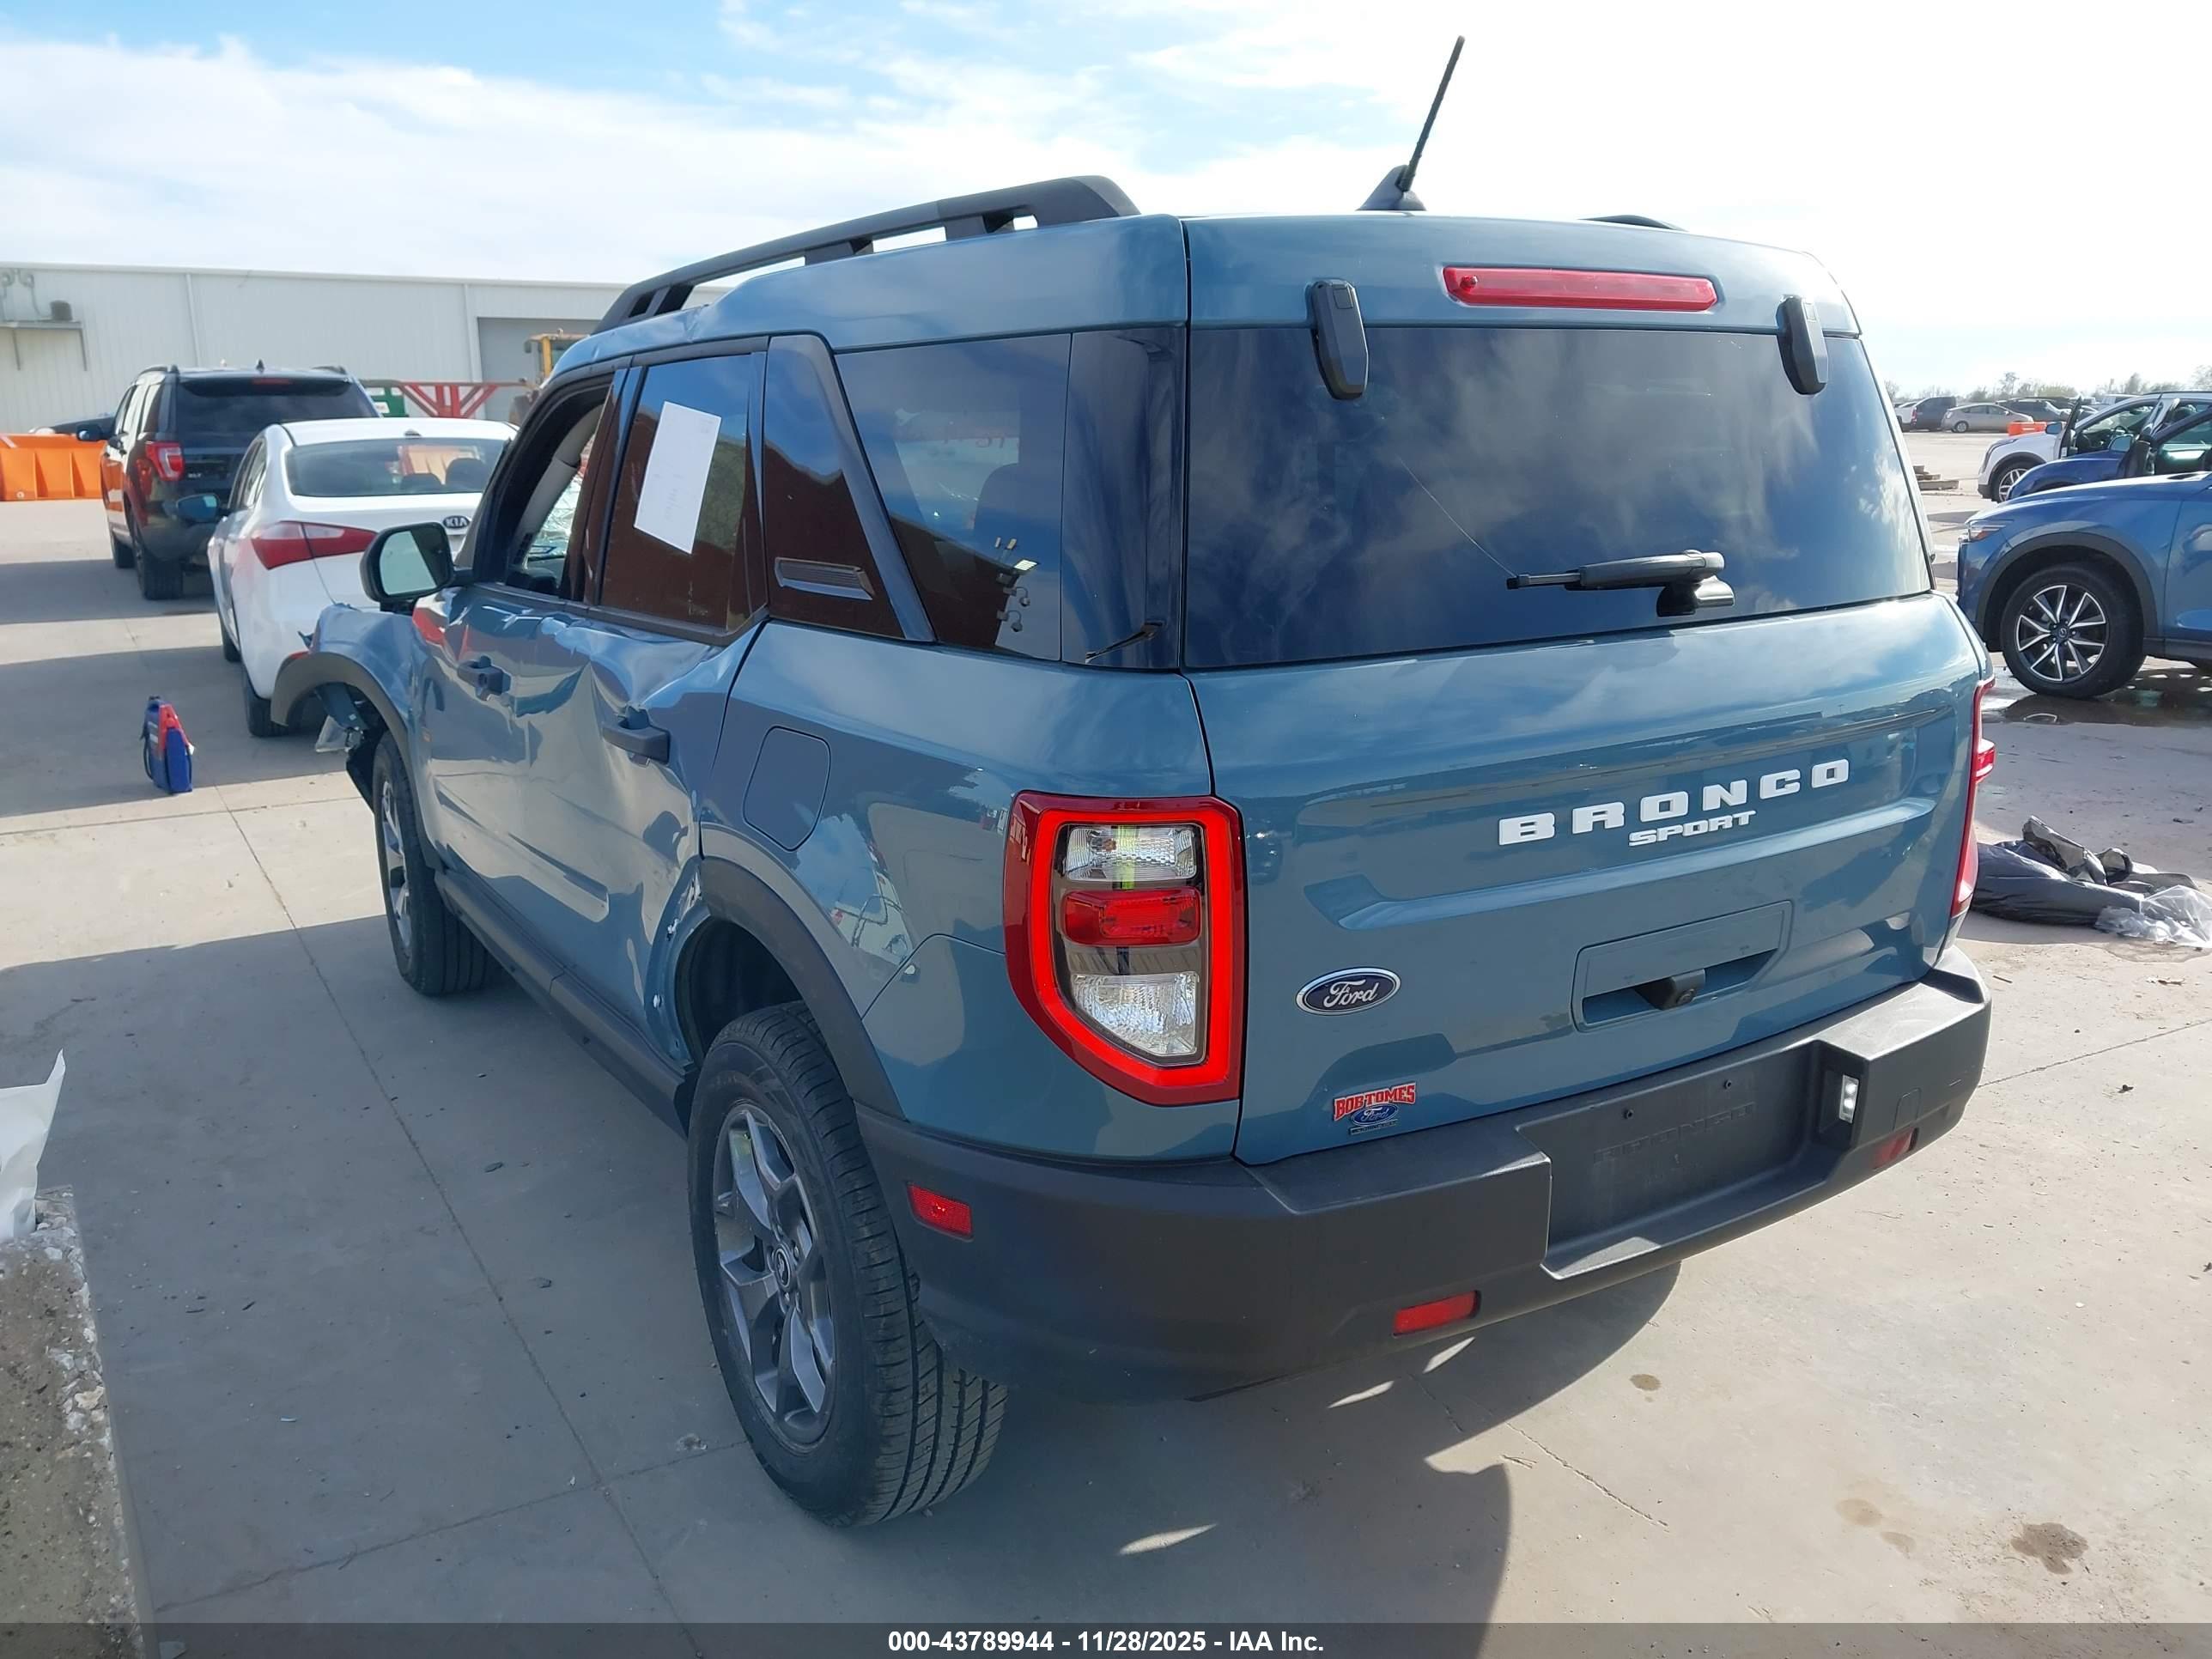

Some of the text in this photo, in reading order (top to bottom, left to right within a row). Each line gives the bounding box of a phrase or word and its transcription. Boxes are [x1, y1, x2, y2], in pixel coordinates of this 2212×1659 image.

[446, 517, 468, 526] KIA
[1498, 758, 1850, 846] BRONCO
[1628, 810, 1757, 847] SPORT
[1323, 979, 1380, 1008] Ford
[1334, 1083, 1416, 1121] BOB TOMES
[1360, 1106, 1389, 1122] Ford
